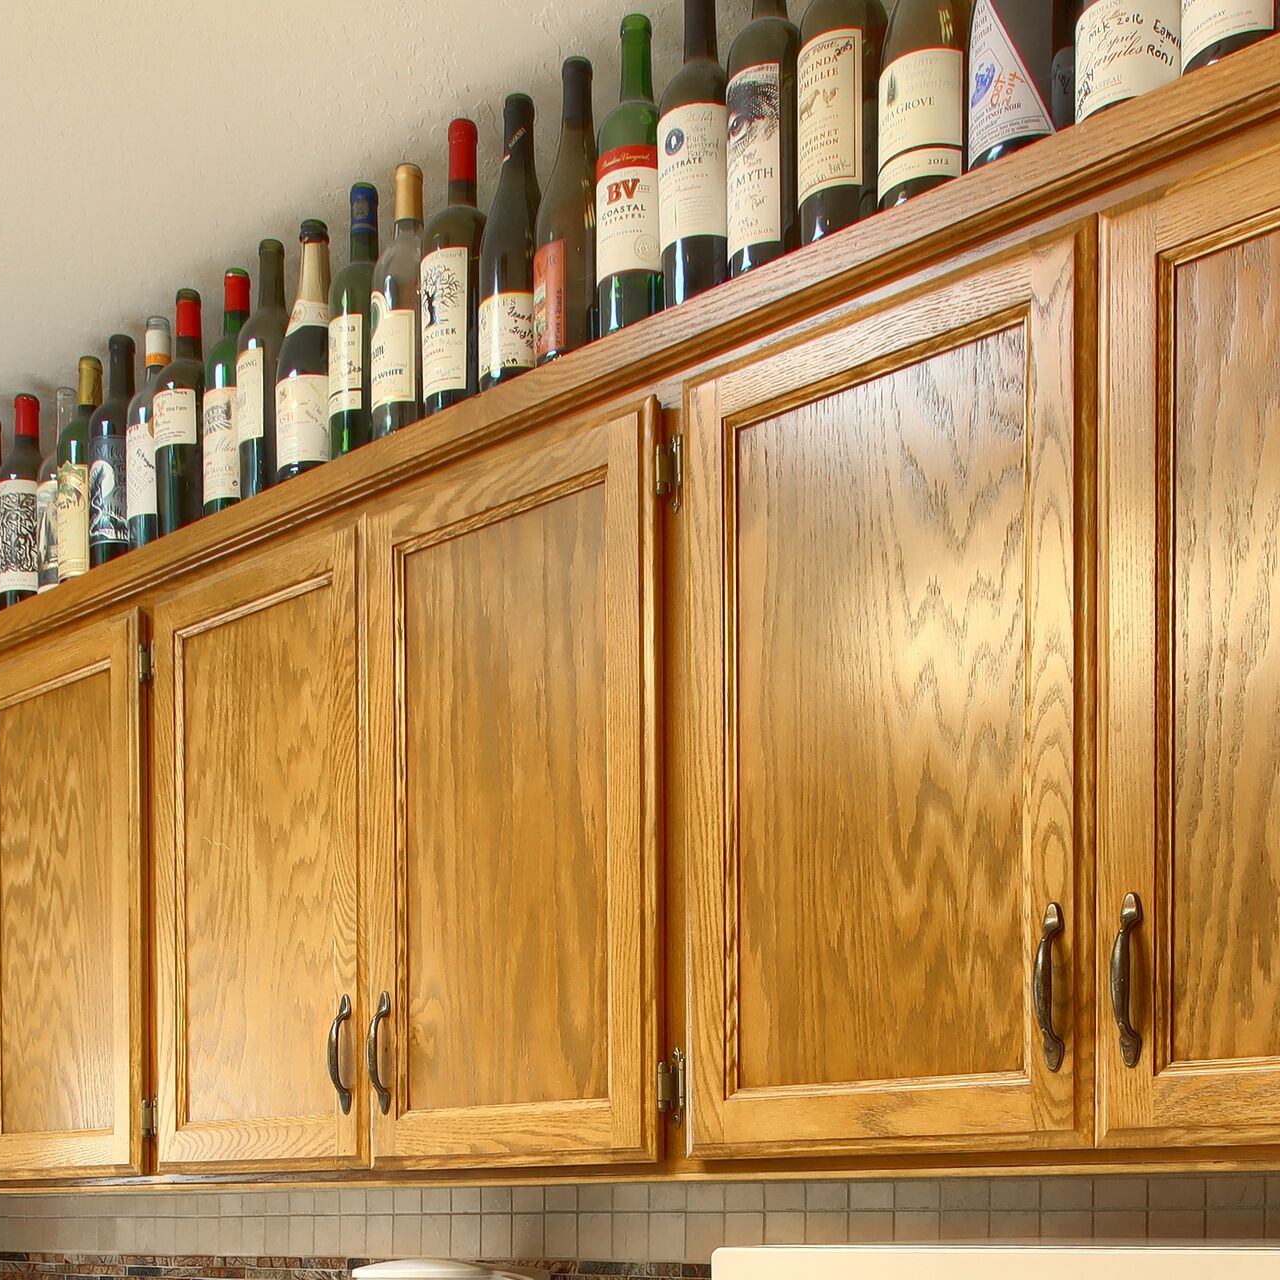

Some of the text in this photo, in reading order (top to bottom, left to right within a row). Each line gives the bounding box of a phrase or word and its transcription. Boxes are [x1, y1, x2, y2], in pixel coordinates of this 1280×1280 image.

[974, 16, 988, 32] Bon
[896, 96, 935, 114] GROVE
[736, 167, 774, 187] MYTH
[606, 178, 640, 206] BV
[601, 203, 647, 221] COASTAL
[431, 327, 457, 340] CREEK
[378, 368, 404, 380] WHITE
